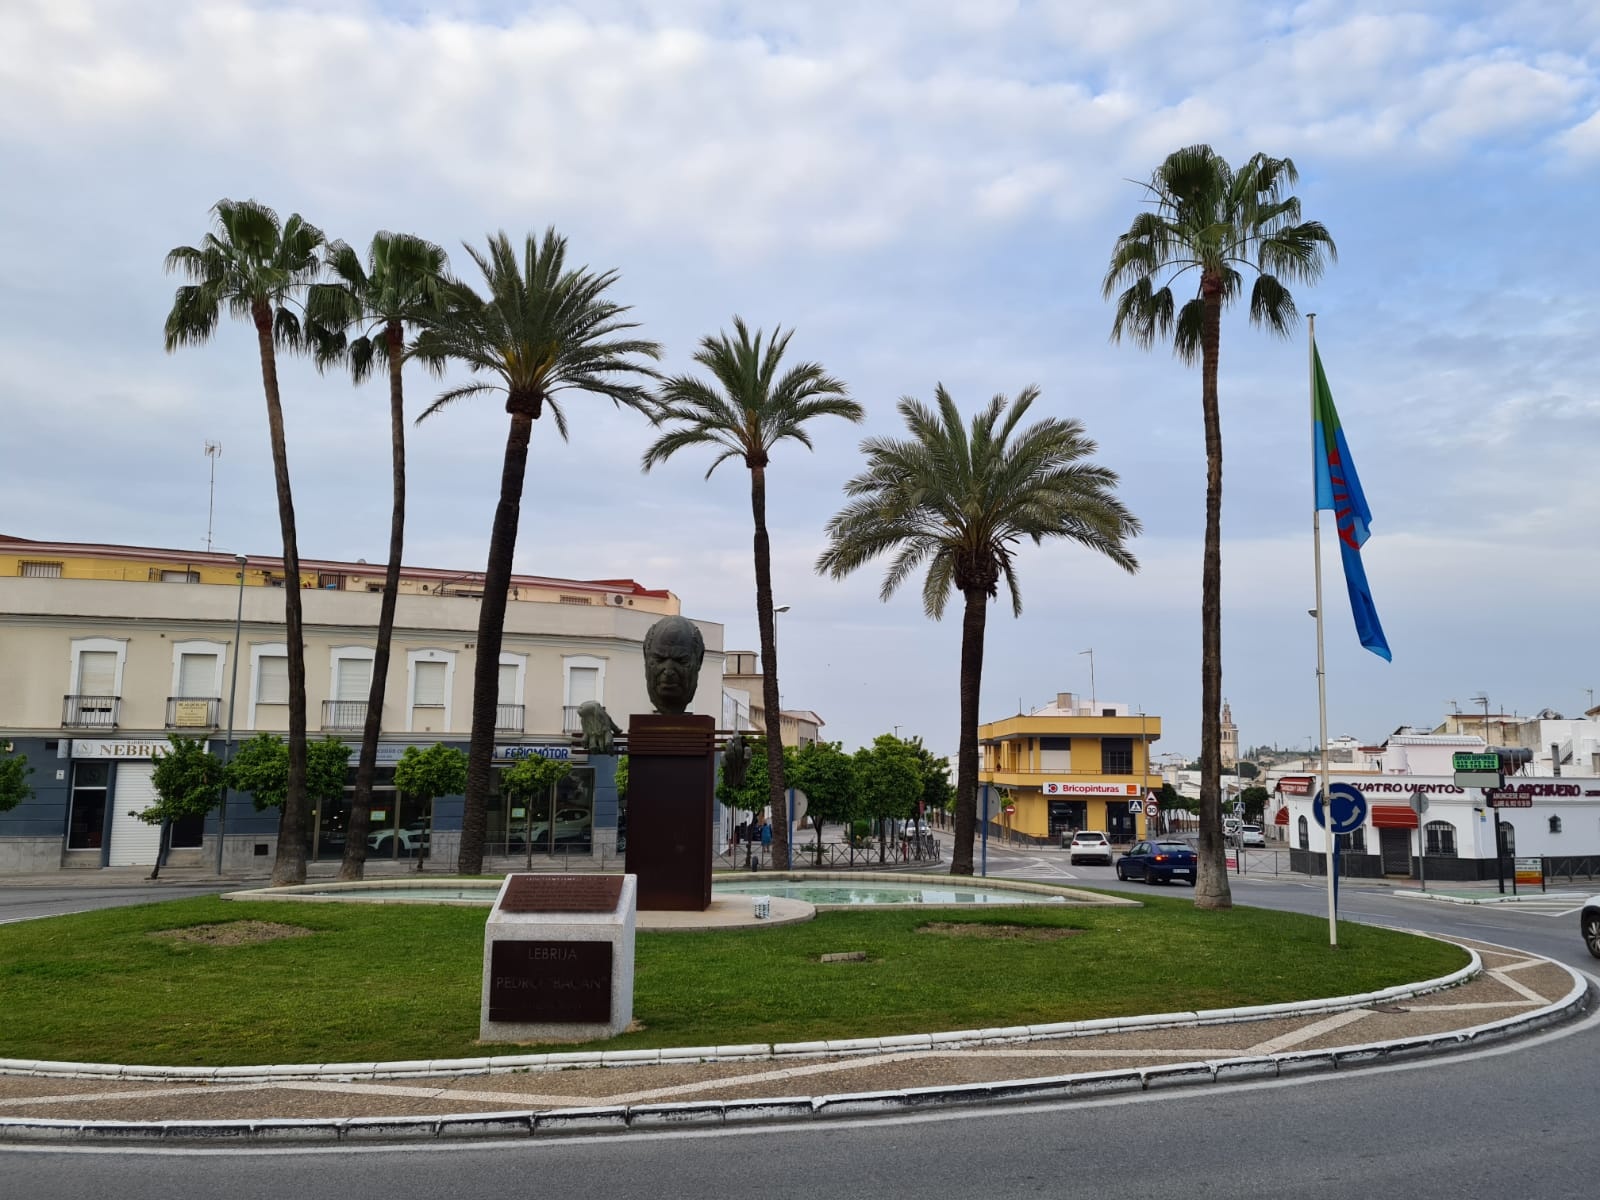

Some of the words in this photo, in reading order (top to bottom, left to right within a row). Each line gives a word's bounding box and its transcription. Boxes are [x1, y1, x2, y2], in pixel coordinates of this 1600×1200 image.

[1062, 784, 1120, 794] Bricopinturas
[1404, 783, 1465, 794] VIENTOS
[528, 947, 577, 960] LEBRIJA
